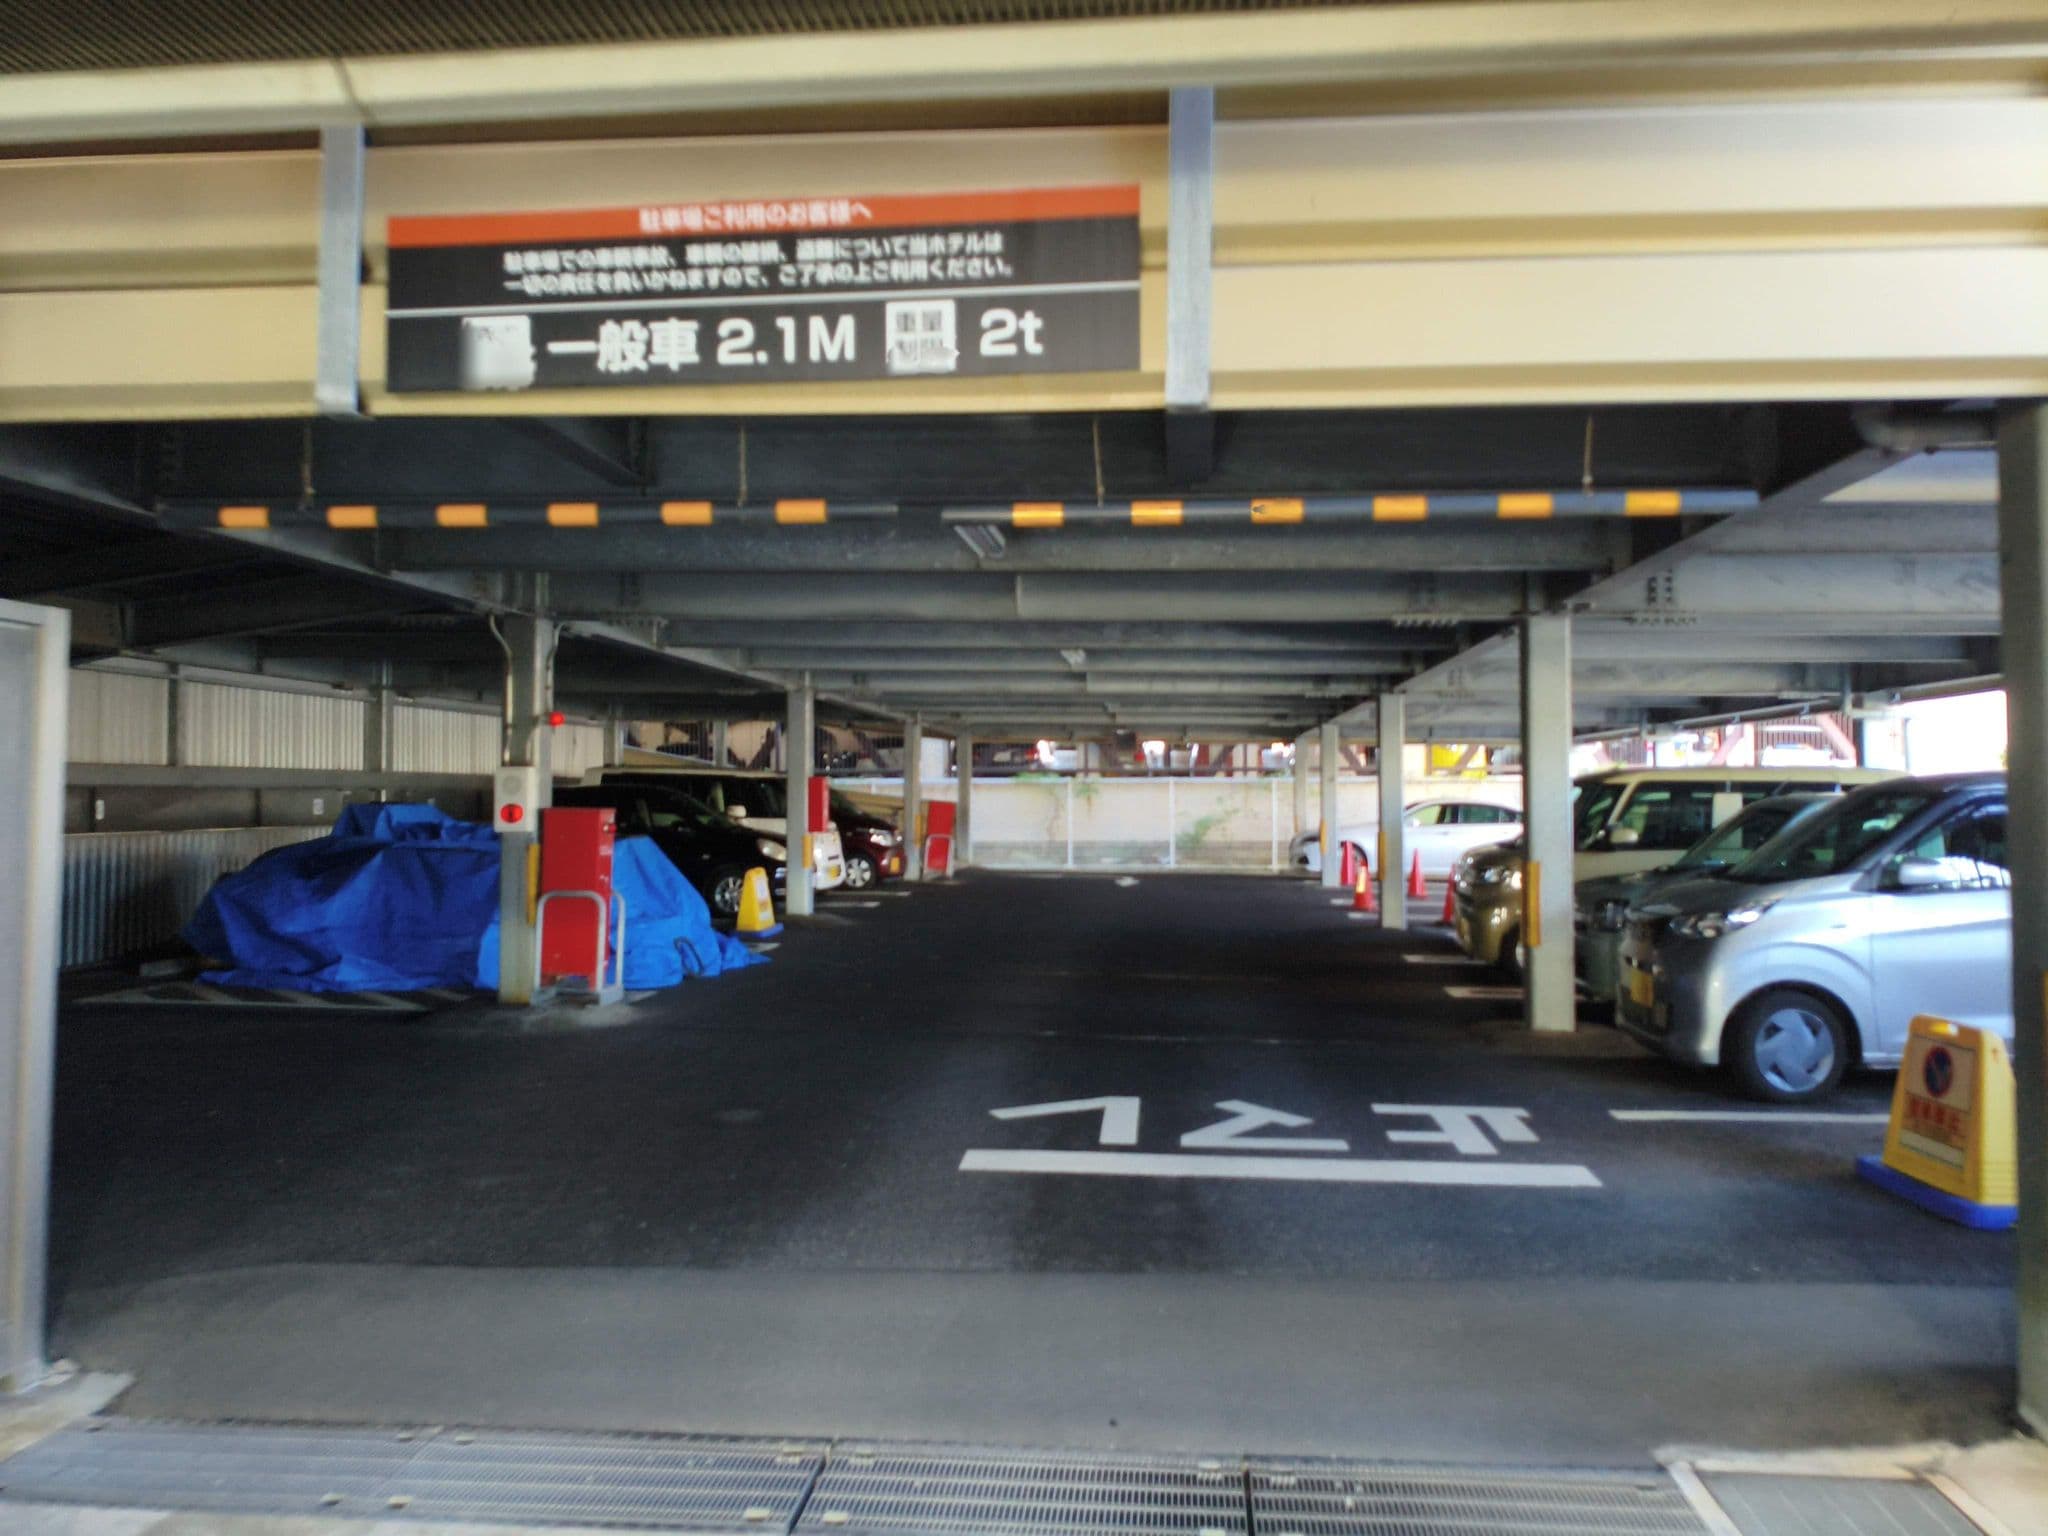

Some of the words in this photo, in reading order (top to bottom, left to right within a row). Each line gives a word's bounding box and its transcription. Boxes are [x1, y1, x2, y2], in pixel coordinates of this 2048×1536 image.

[547, 317, 700, 373] 一般車
[717, 314, 855, 365] 2.1M
[980, 308, 1043, 356] 2t
[989, 1096, 1540, 1155] 止マレ
